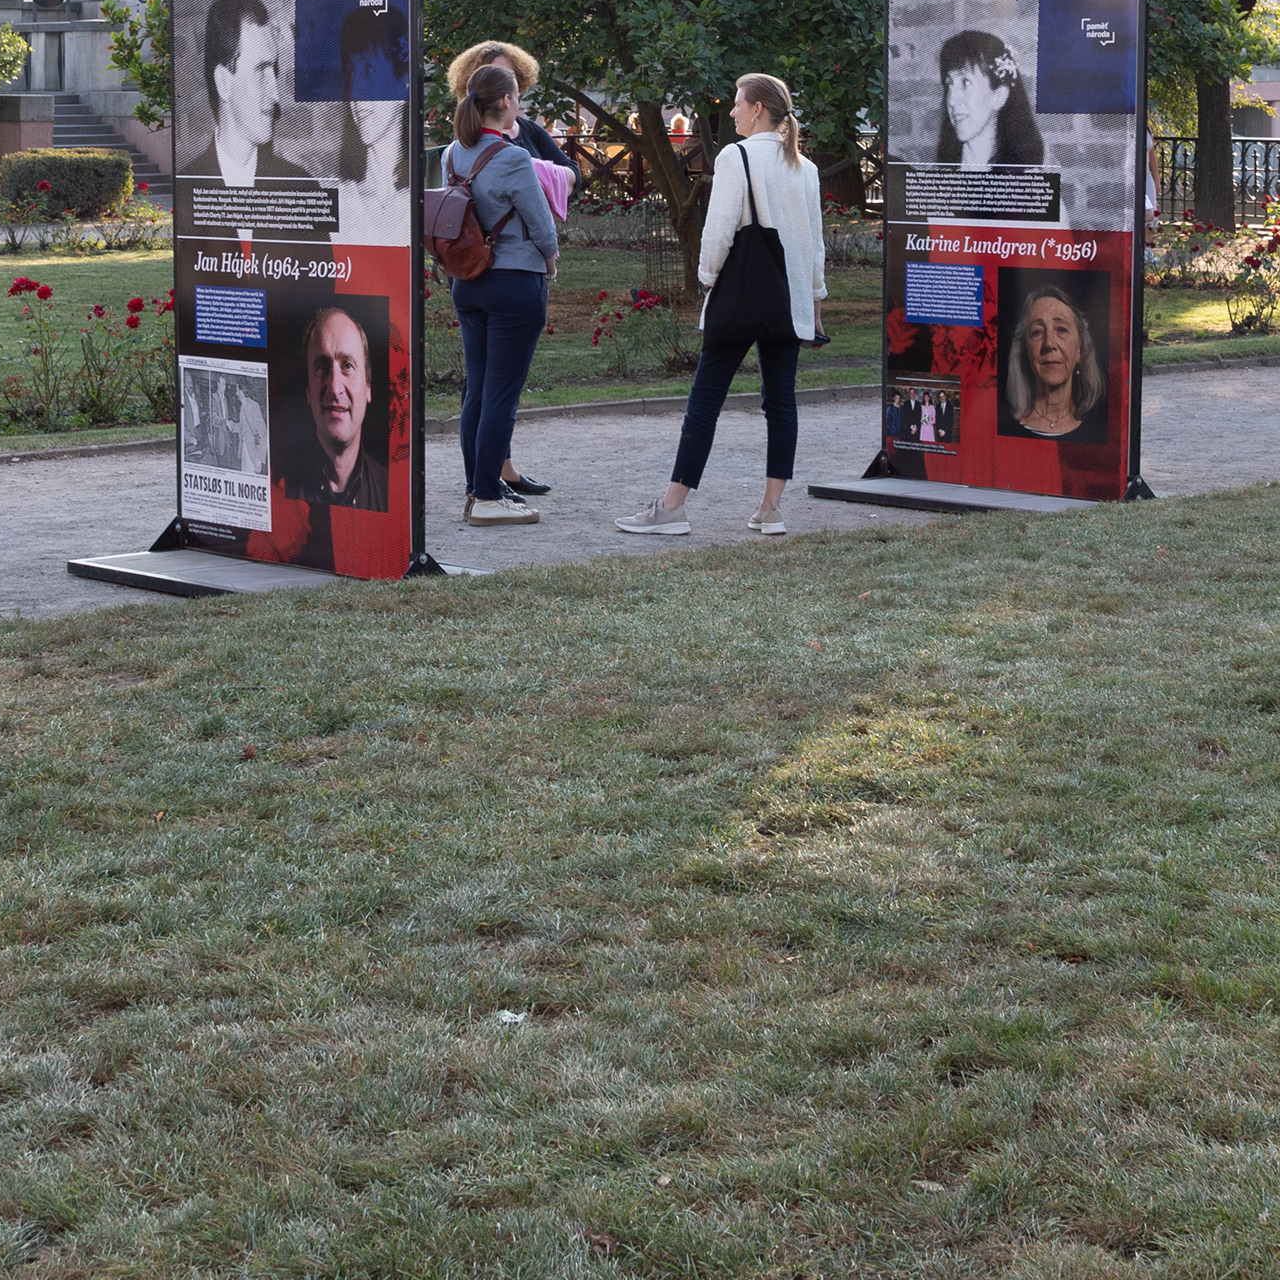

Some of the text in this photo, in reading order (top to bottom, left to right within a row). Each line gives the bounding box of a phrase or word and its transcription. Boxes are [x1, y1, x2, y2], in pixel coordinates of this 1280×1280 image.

[905, 234, 960, 252] Katrine
[963, 236, 1037, 259] Lundgren
[194, 251, 218, 272] Jan
[221, 252, 260, 279] Hájek
[184, 473, 267, 502] STATSLØS TIL NORGE
